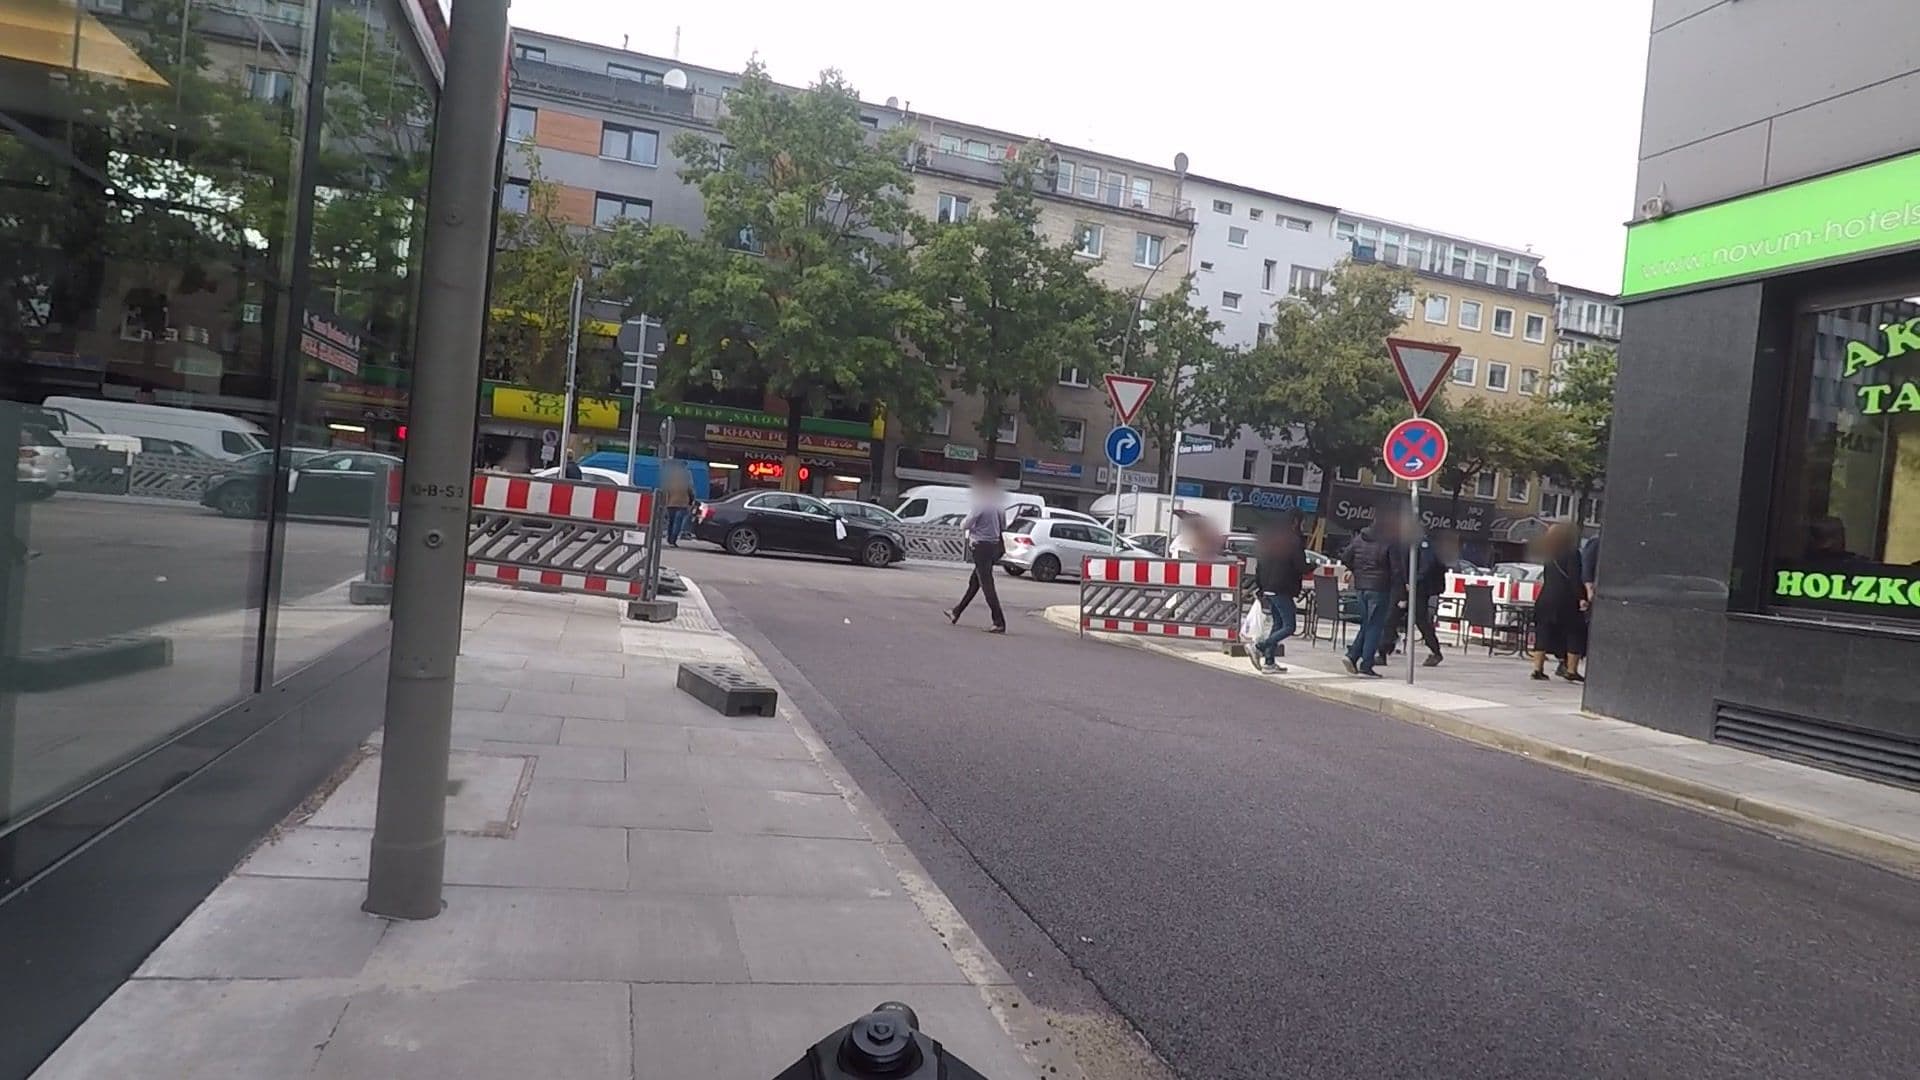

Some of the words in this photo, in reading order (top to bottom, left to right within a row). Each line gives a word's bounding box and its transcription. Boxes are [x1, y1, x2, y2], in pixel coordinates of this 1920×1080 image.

[722, 426, 762, 440] KHAN
[768, 431, 812, 446] PLZA
[744, 451, 784, 462] KHAN
[1335, 500, 1376, 521] Spiel
